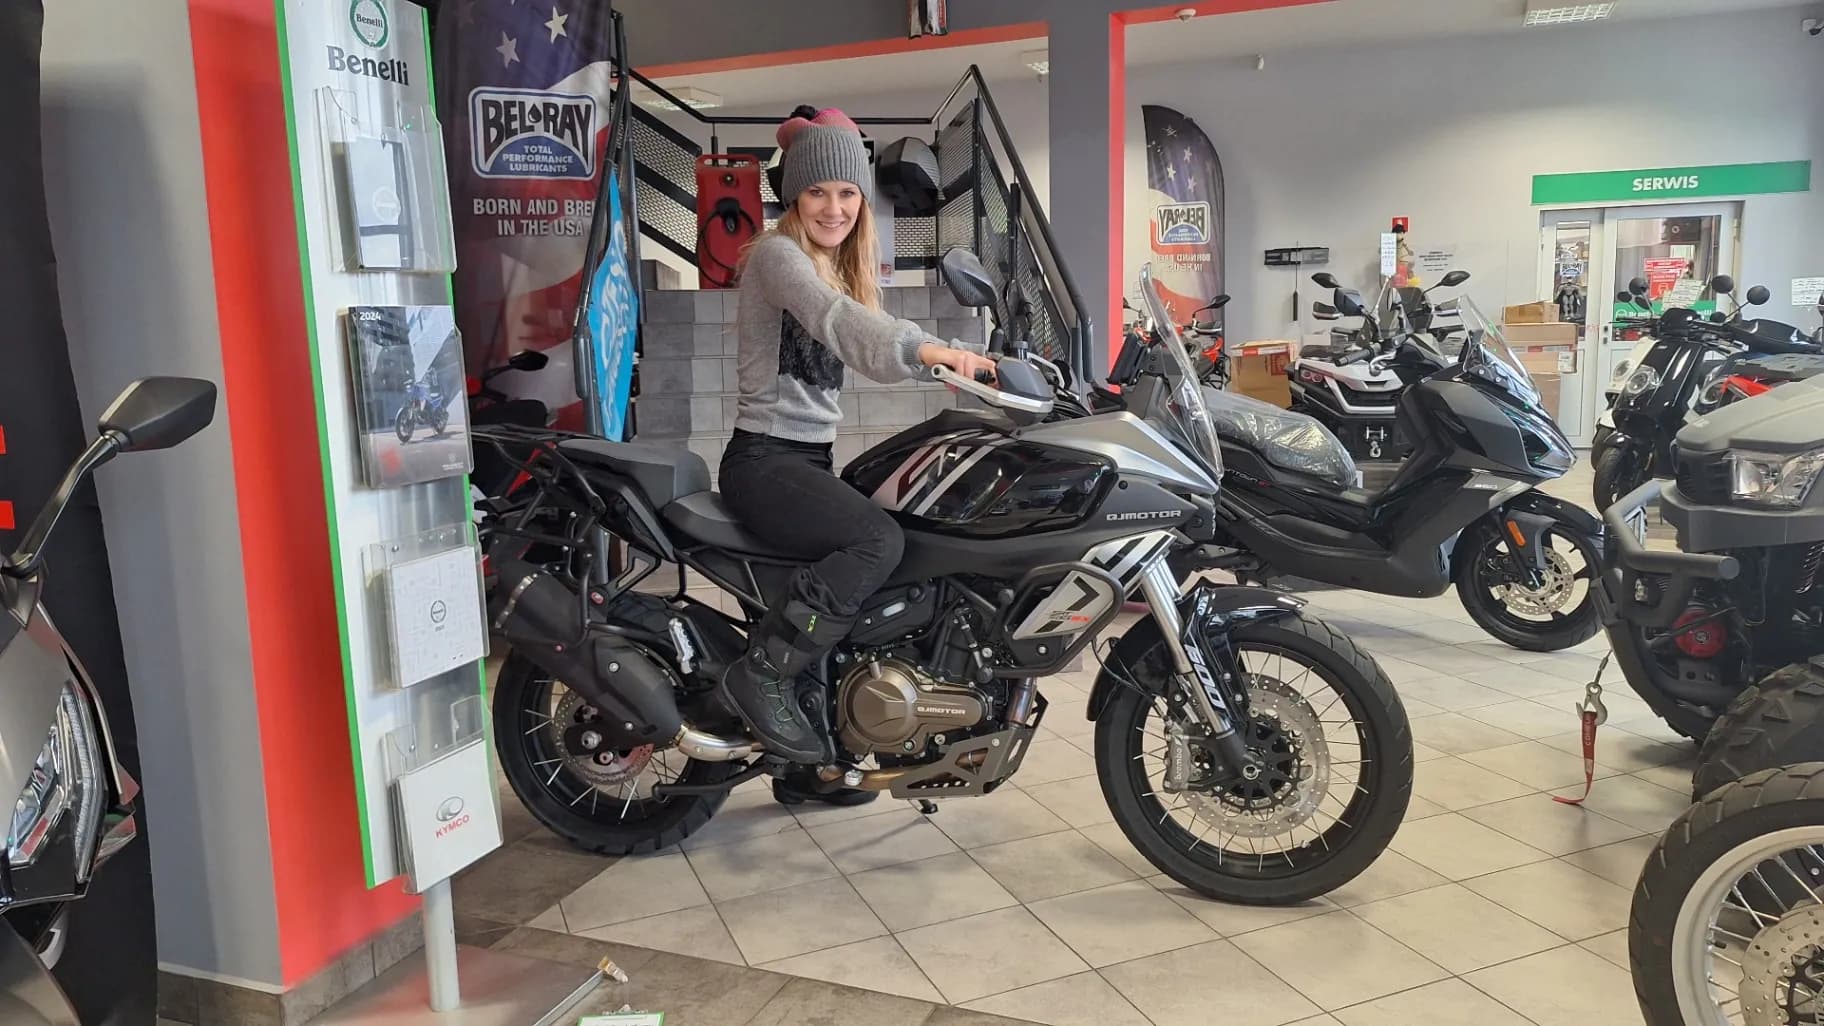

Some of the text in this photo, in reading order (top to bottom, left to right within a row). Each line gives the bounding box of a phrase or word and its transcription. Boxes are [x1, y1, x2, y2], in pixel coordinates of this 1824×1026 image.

[356, 14, 383, 28] Benelli
[326, 45, 409, 86] Benelli
[523, 145, 553, 154] TOTAL
[502, 153, 574, 164] PERFORMANCE
[509, 163, 568, 173] LUBRICANTS
[1632, 175, 1699, 192] SERWIS
[473, 198, 521, 215] BORN
[527, 199, 558, 215] AND
[498, 219, 584, 236] IN THE USA
[359, 312, 381, 321] 2024
[1106, 509, 1182, 521] QJMOTOR
[917, 706, 966, 715] QJMOTOR
[1174, 747, 1183, 780] brembo
[436, 814, 470, 839] KYMCO
